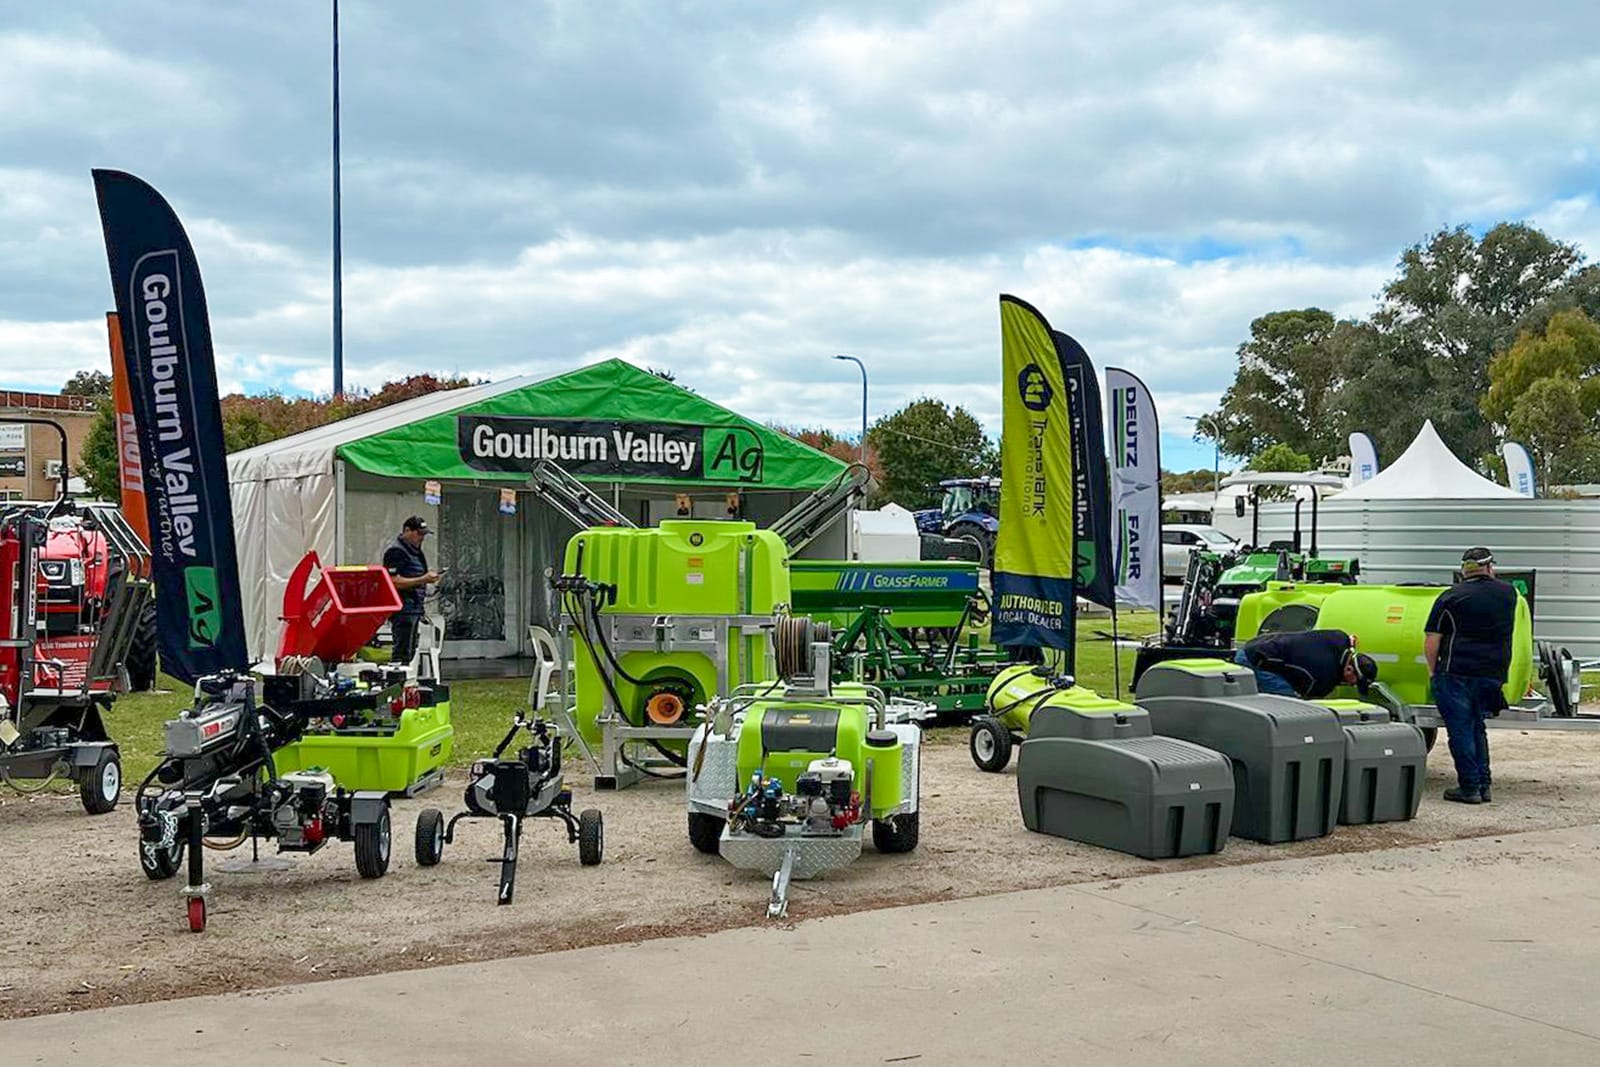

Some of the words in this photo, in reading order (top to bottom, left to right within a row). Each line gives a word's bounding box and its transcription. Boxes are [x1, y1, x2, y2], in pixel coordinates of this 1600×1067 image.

[143, 273, 184, 441] Goulburn
[473, 425, 607, 461] Goulburn
[612, 429, 696, 471] Valley
[711, 433, 764, 482] Ag
[1125, 386, 1139, 468] DEUTZ
[1128, 515, 1141, 580] FAHR
[1028, 612, 1062, 630] DEALER
